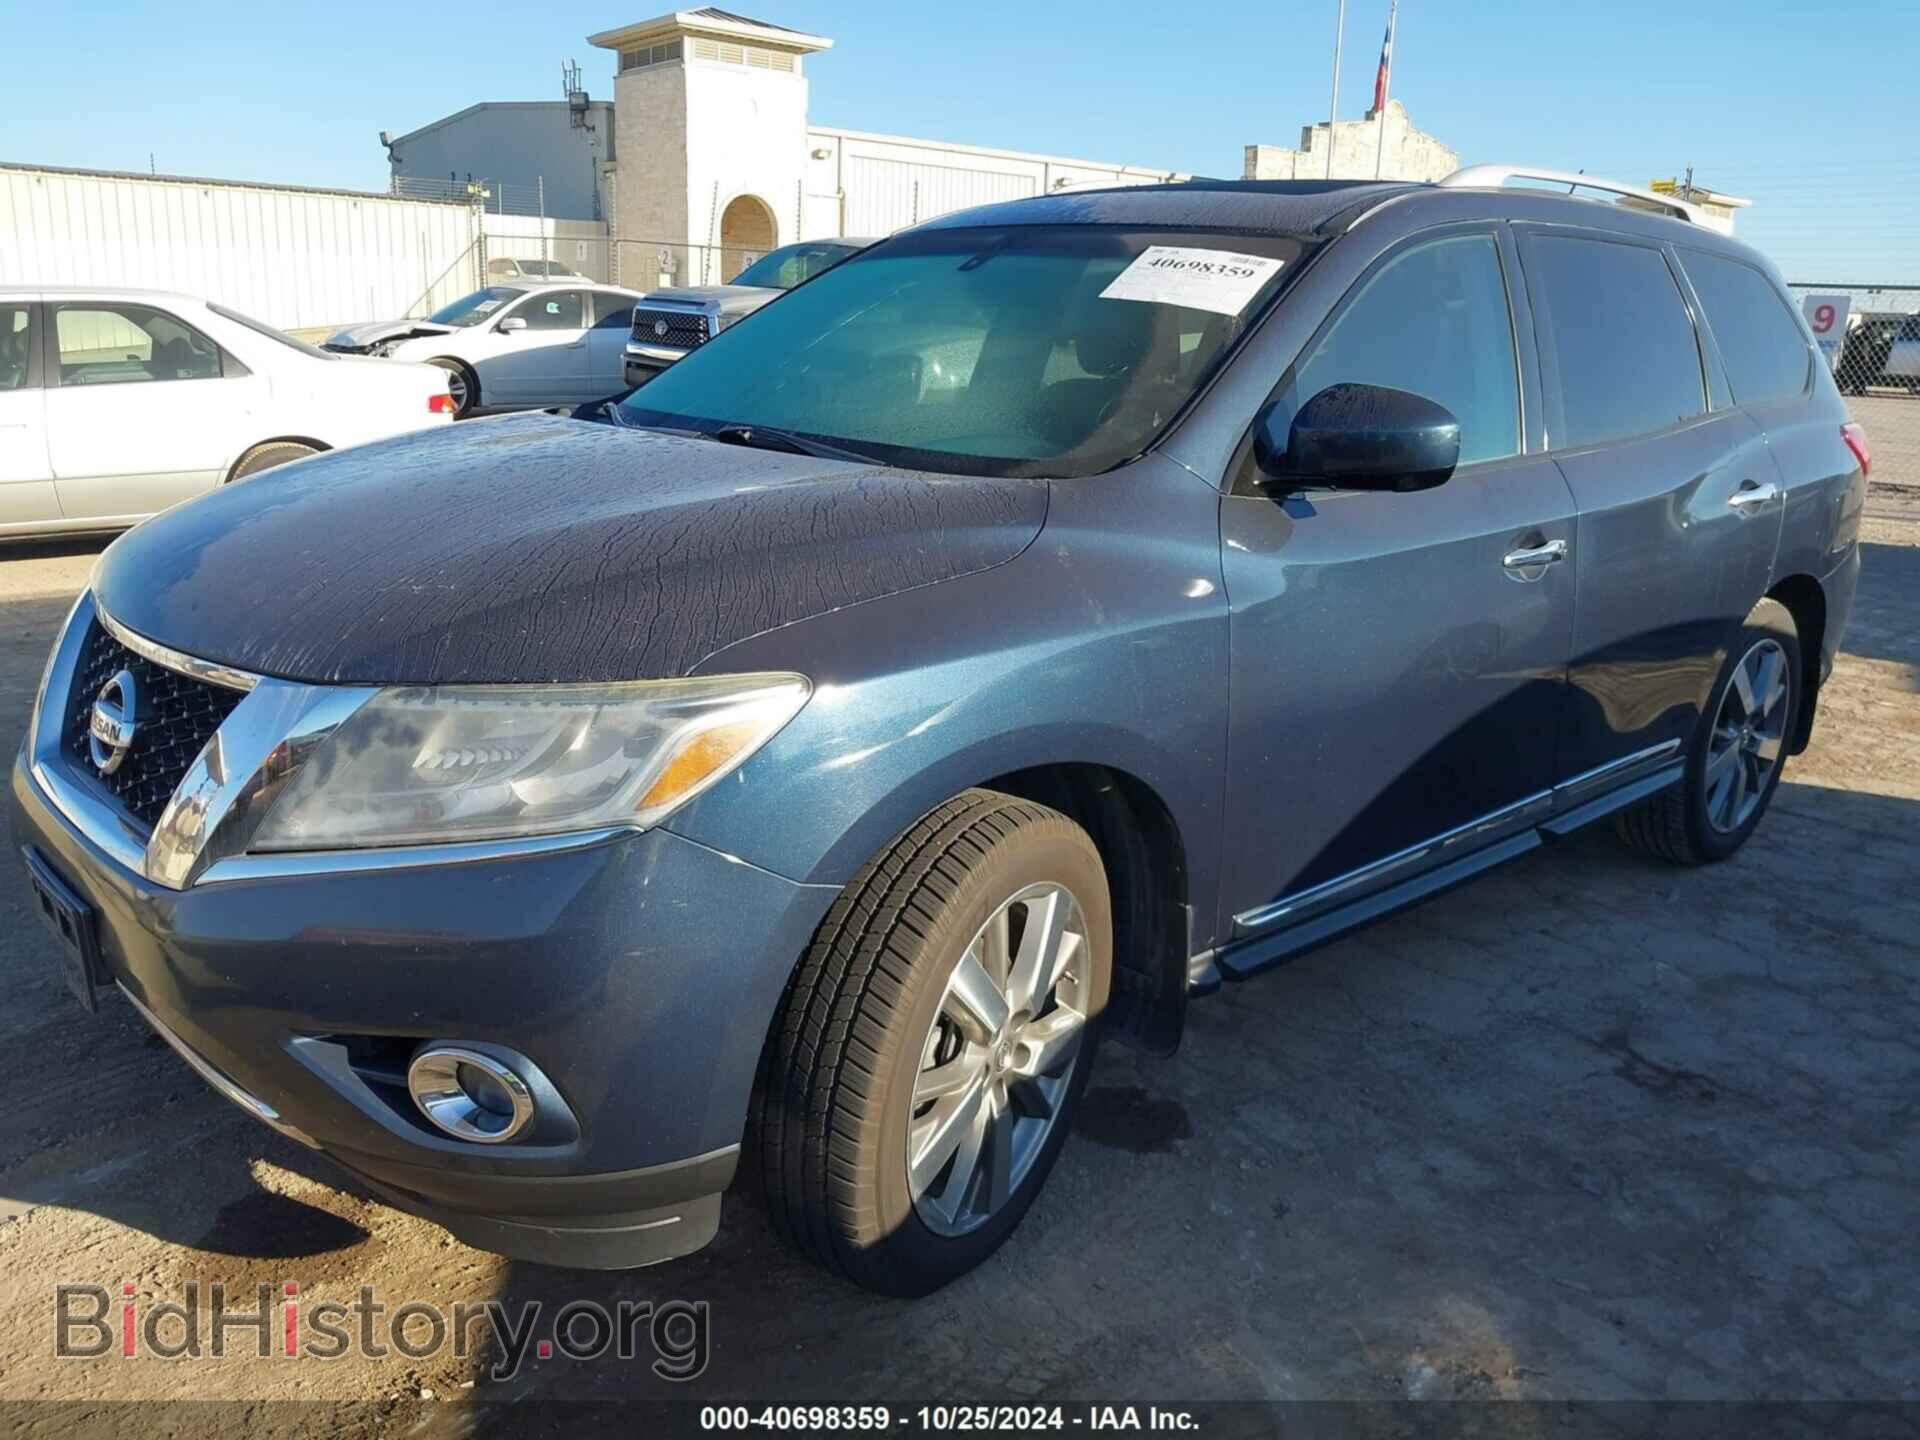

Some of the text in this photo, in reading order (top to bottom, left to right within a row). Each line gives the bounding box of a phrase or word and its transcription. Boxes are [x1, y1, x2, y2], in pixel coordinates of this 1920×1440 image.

[662, 250, 669, 265] 2
[1148, 257, 1255, 279] 40698359
[1813, 305, 1834, 333] 9
[92, 712, 122, 741] SSAN
